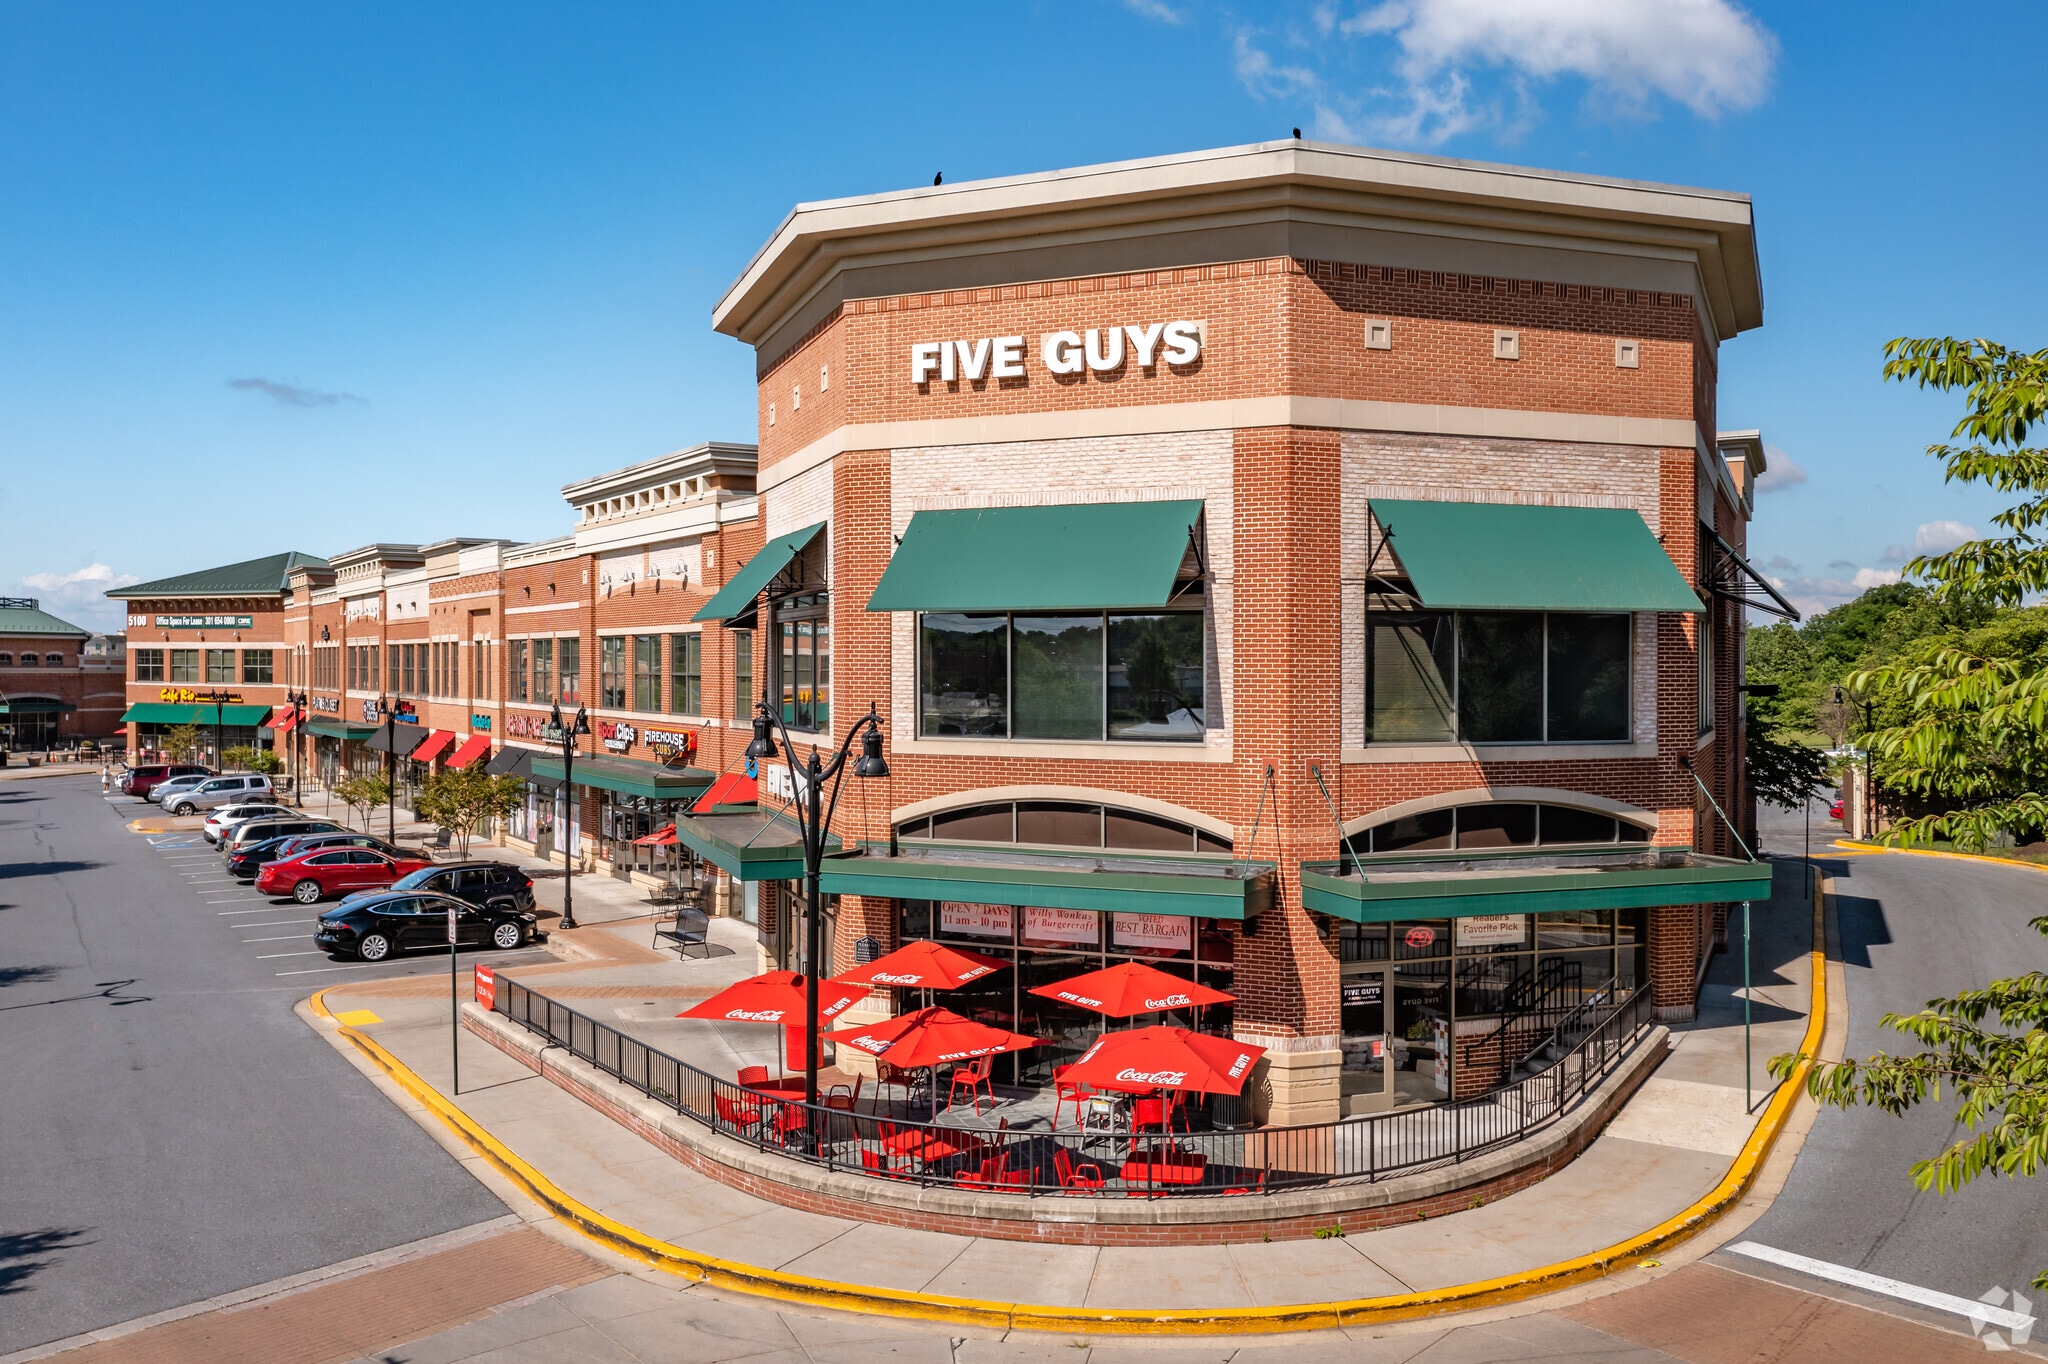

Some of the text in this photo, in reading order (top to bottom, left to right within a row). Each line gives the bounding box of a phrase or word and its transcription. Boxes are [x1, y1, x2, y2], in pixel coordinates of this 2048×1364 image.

[912, 320, 1201, 384] FIVE GUYS
[128, 615, 147, 627] 5100
[156, 616, 203, 627] Office Space For Lease
[205, 616, 214, 626] 301
[180, 688, 195, 701] Rio
[644, 730, 685, 750] FIREHOUSE
[655, 743, 671, 755] SUBS
[942, 902, 1010, 916] OPEN 7 DAYS
[1056, 910, 1093, 920] Wonkas
[944, 914, 952, 924] 11
[955, 917, 970, 925] am
[981, 917, 989, 926] 10
[992, 919, 1007, 930] pm
[1028, 918, 1037, 928] of
[1138, 914, 1164, 923] VOTED
[1115, 921, 1139, 933] BEST
[1142, 923, 1189, 937] BARGAIN
[1463, 922, 1519, 934] Favorite Pick
[1406, 929, 1434, 944] OPEN
[870, 972, 924, 985] Coca-Cola
[957, 966, 990, 981] FIVE GUYS
[1344, 987, 1380, 996] FIVE GUYS
[1057, 991, 1103, 1007] FIVE GUYS
[1145, 994, 1191, 1010] Coca-Cola
[822, 997, 851, 1017] FIVE GUYS
[725, 1008, 786, 1022] Coca-Cola
[938, 1051, 969, 1061] FIVE
[1228, 1053, 1251, 1079] FIVE GUYS
[1115, 1068, 1188, 1086] Coca-Cola
